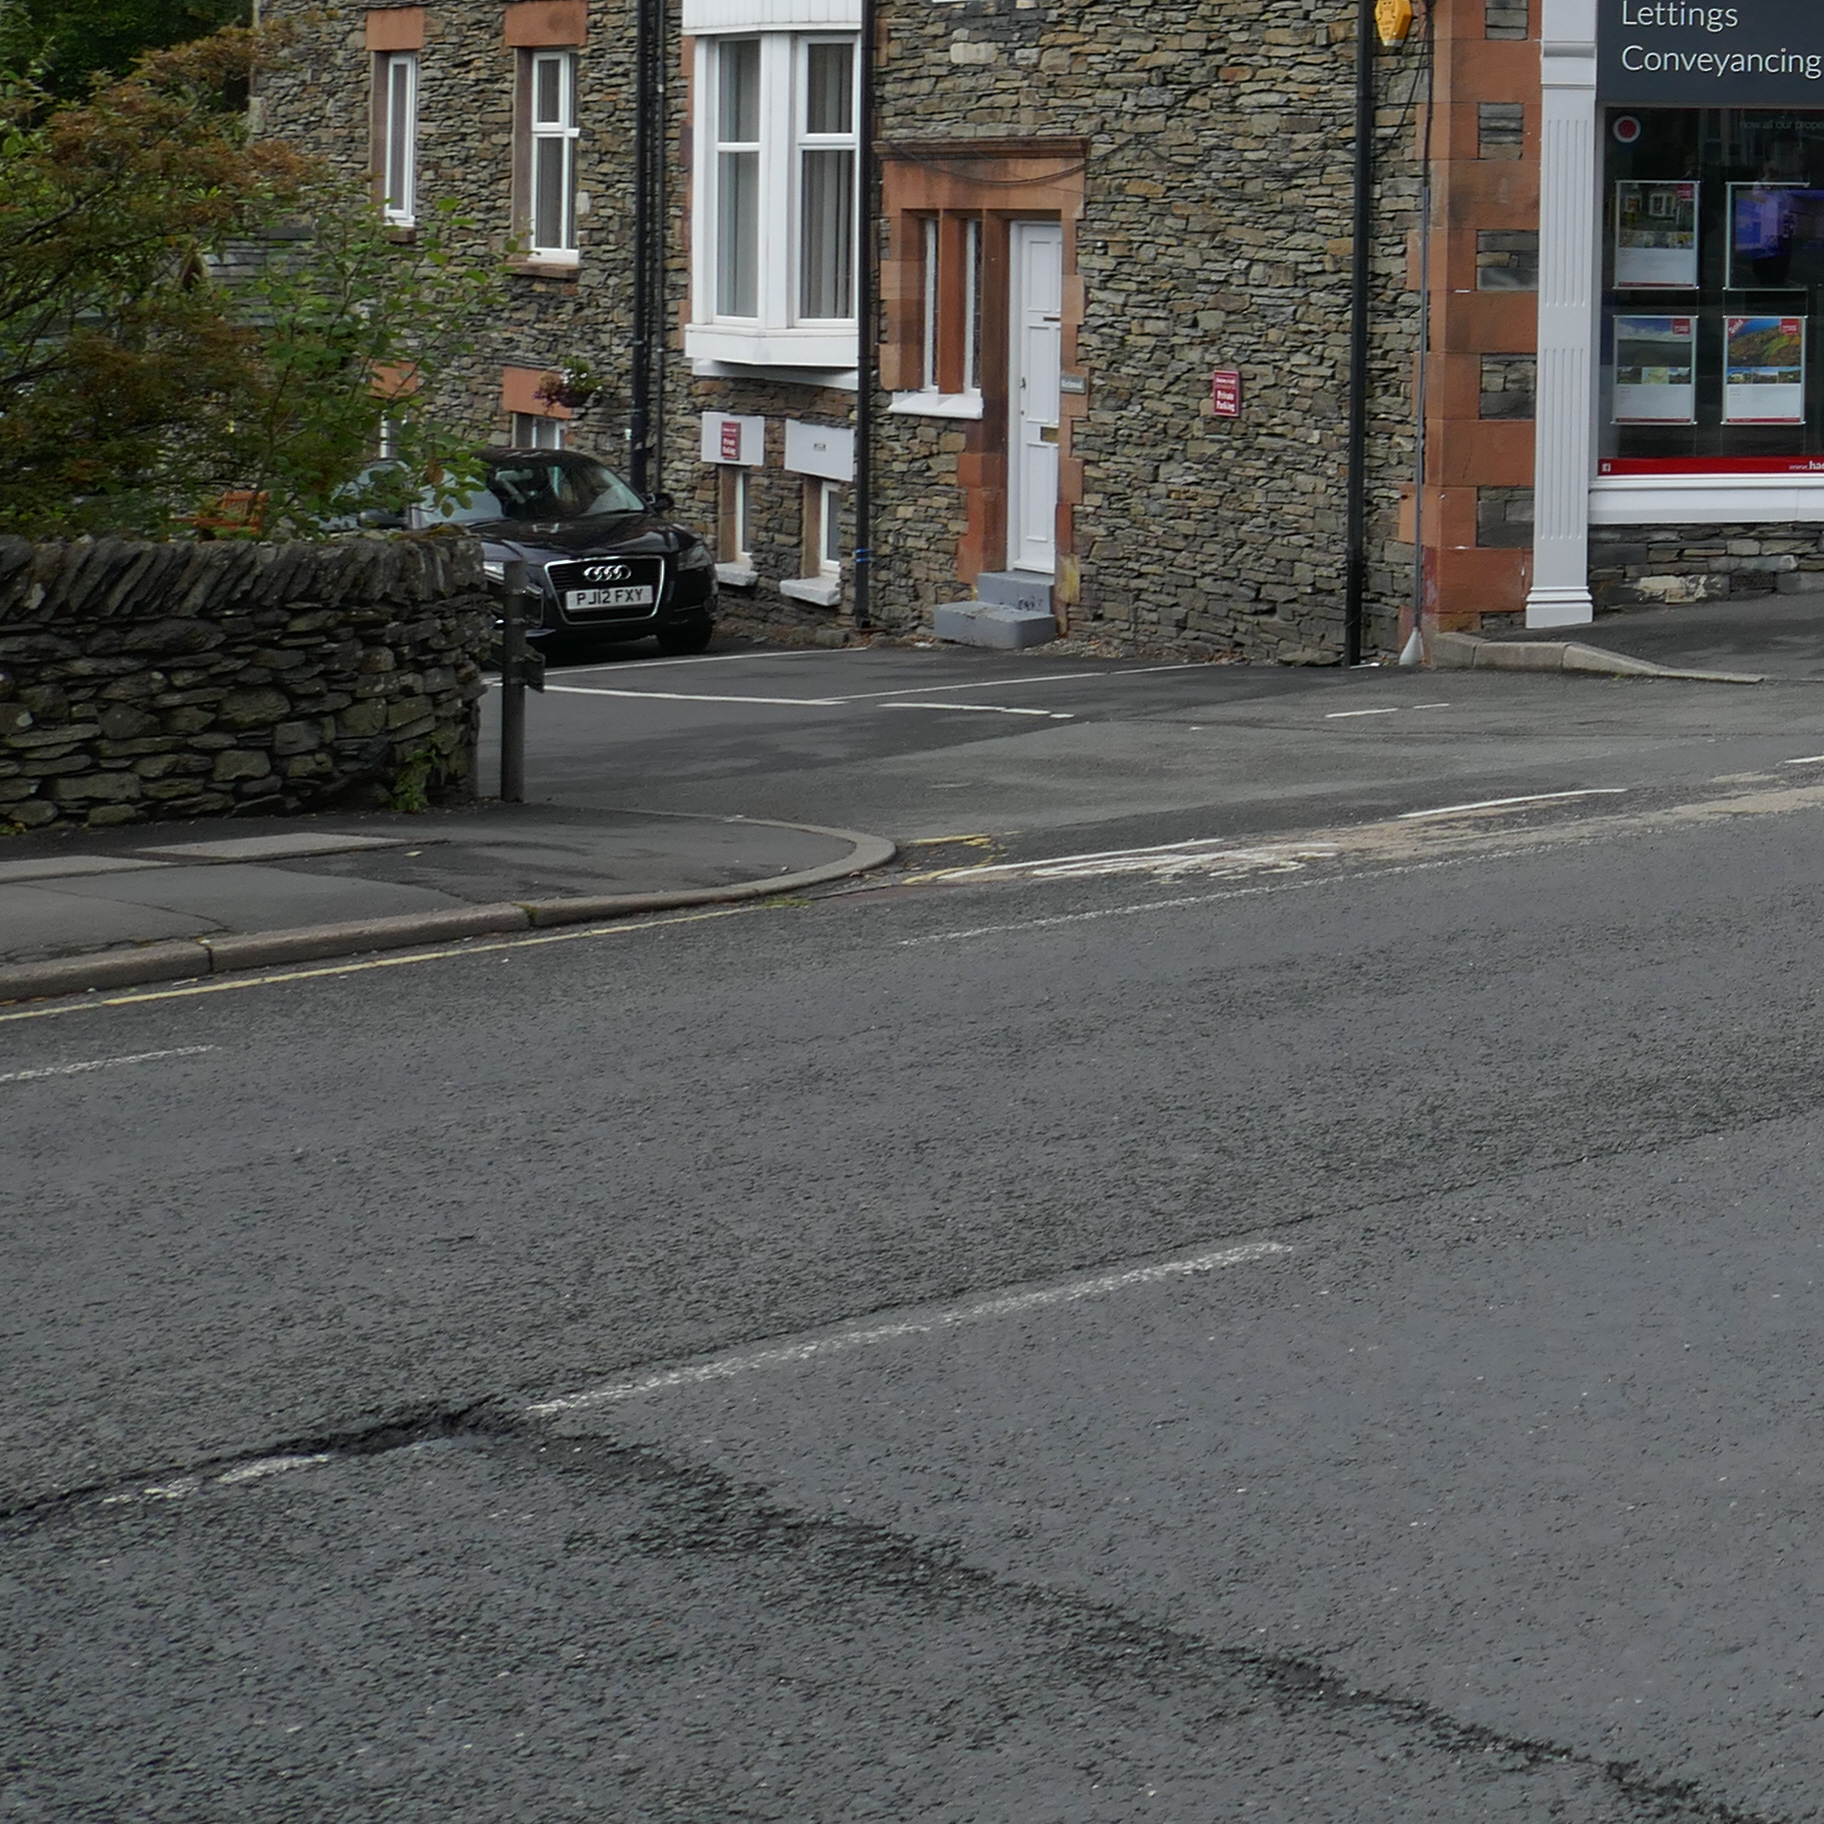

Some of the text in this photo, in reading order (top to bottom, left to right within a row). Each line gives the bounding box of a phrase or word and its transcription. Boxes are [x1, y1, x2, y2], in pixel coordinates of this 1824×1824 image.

[1621, 0, 1739, 34] Lettings
[1621, 44, 1822, 79] Conveyancing
[1217, 389, 1235, 401] Private
[1216, 400, 1236, 413] Parking
[577, 588, 643, 606] PJ12 FXY
